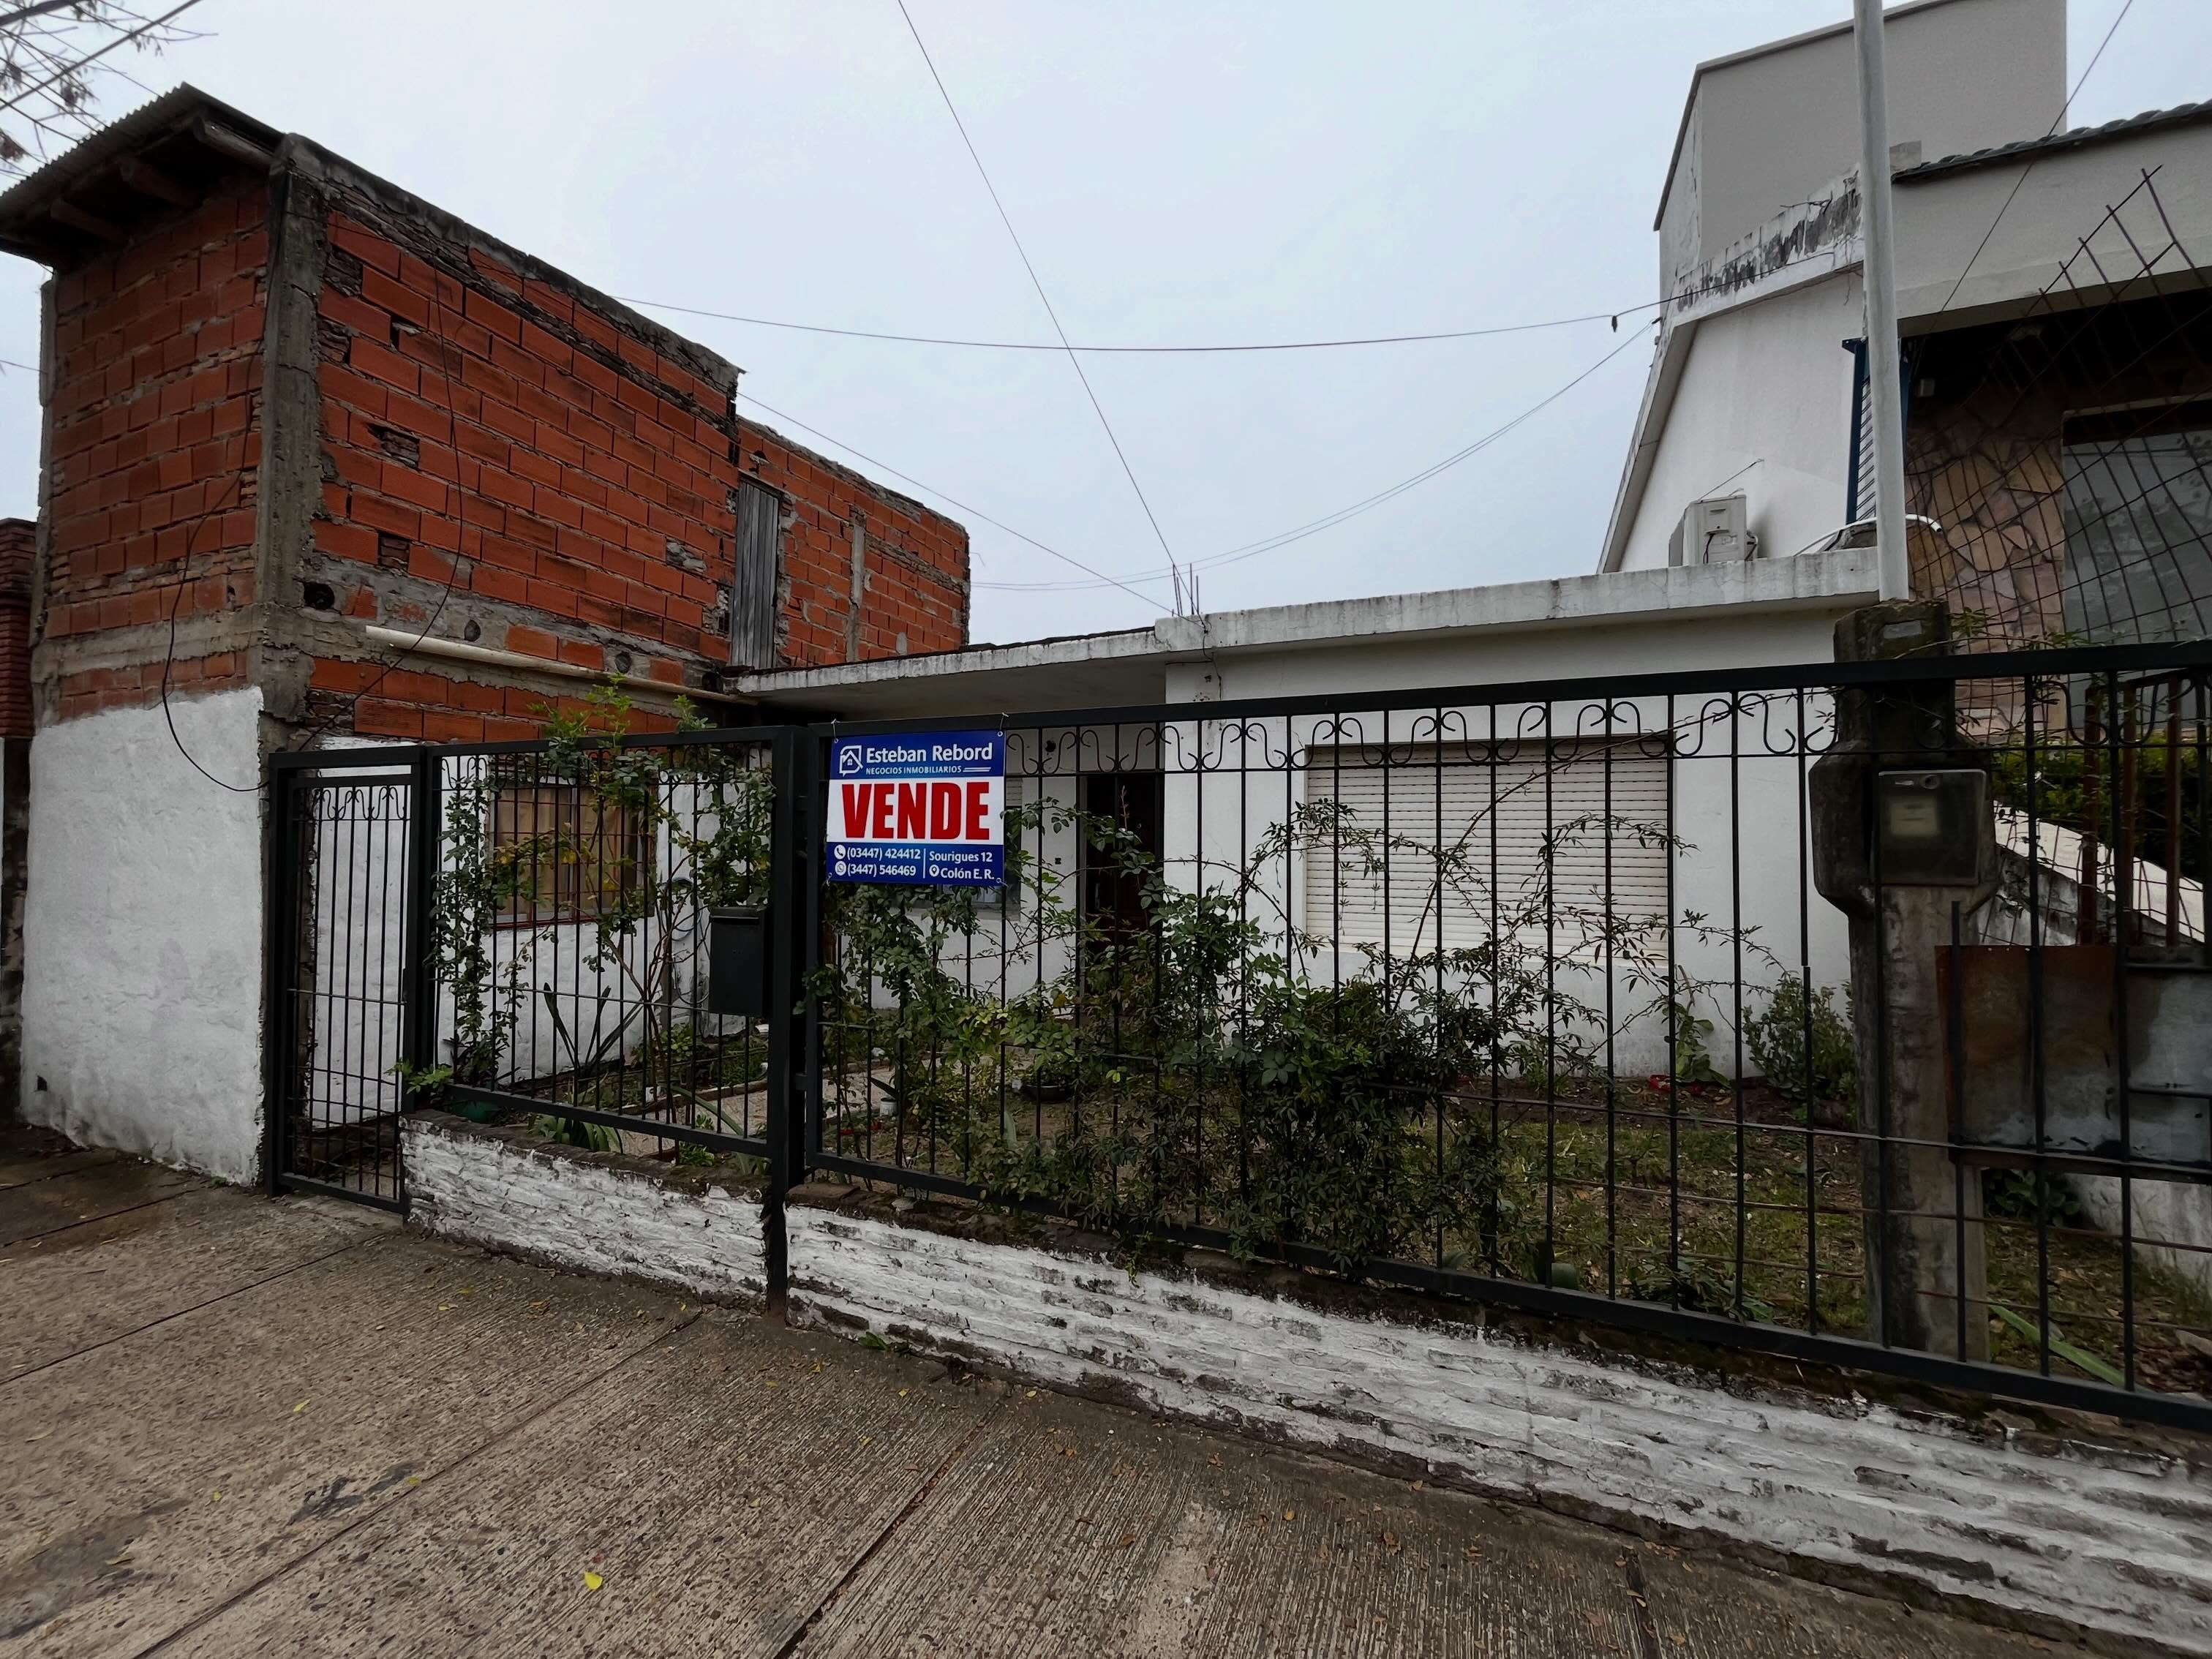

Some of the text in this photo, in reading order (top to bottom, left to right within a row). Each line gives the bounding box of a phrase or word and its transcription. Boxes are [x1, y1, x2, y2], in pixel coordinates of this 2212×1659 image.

[866, 742, 993, 764] Esteban Rebord
[866, 766, 962, 775] NEGOCIOS INMOBILIARIOS
[842, 782, 989, 840] VENDE
[847, 847, 921, 860] (03447) 424412
[929, 850, 993, 864] Sourigues 12
[847, 864, 916, 877] (3447) 546469
[941, 867, 995, 879] Colón E. R.
